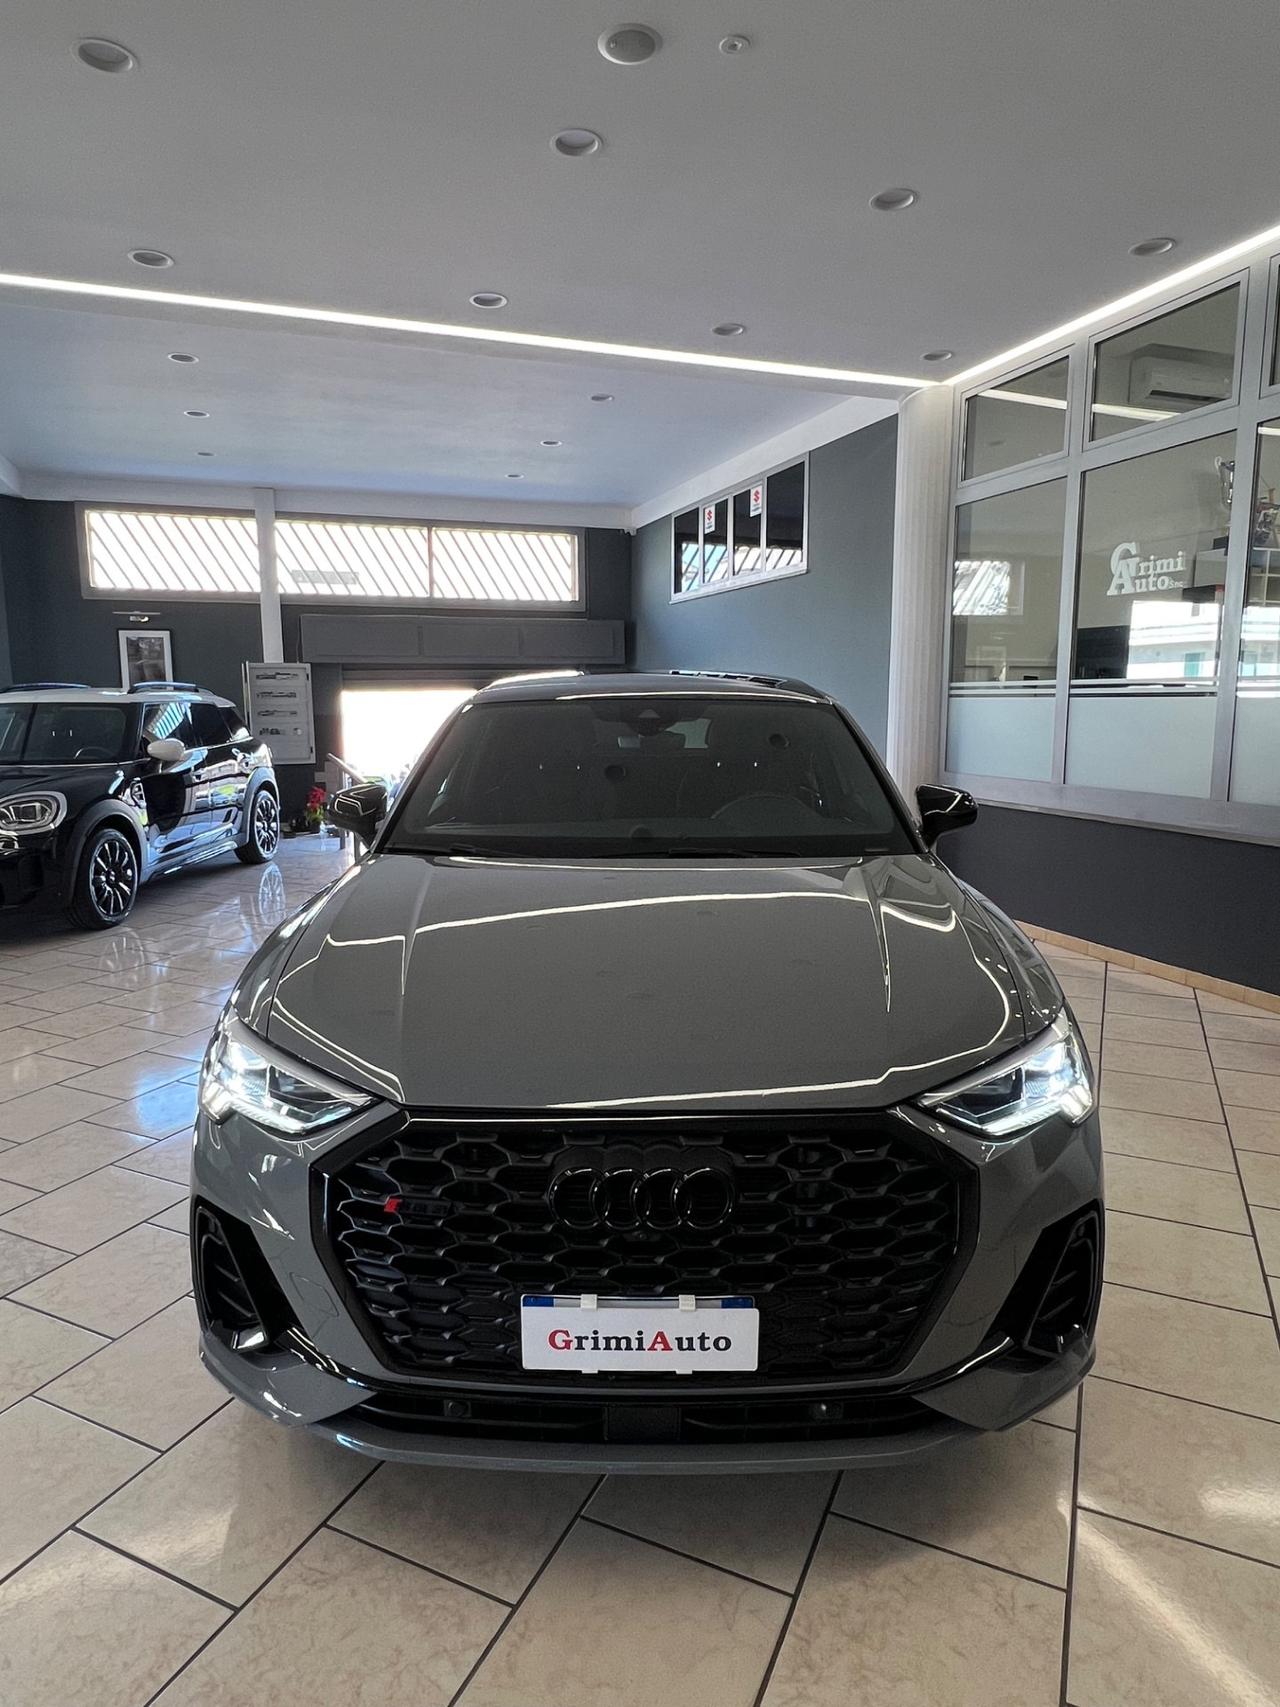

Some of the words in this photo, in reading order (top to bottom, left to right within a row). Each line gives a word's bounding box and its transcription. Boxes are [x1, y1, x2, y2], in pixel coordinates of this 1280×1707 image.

[1110, 541, 1185, 577] Grimi
[1106, 560, 1169, 596] Auto
[547, 1328, 733, 1353] GrimiAuto
